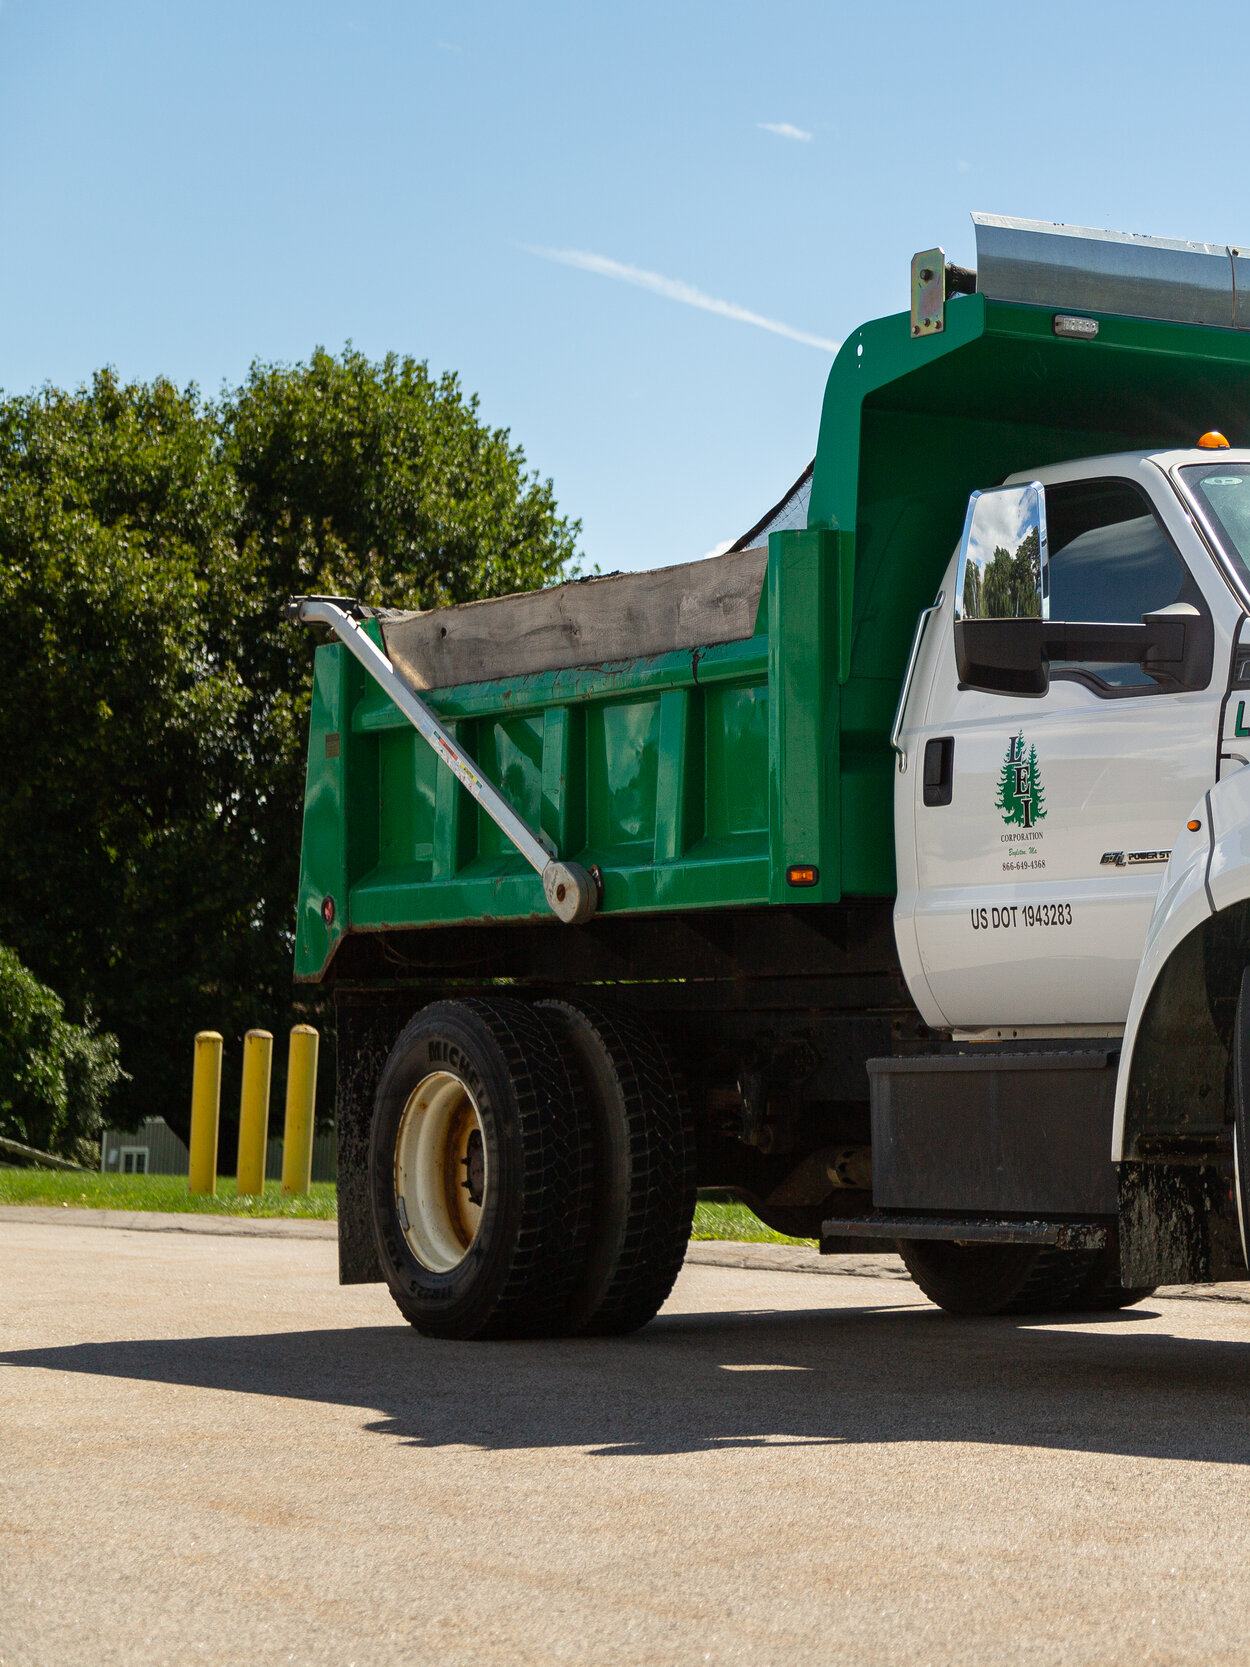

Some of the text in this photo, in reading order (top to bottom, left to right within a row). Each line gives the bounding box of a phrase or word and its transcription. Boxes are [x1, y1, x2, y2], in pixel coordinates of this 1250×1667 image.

[1001, 832, 1044, 842] CORPORATION
[1128, 852, 1158, 861] POWER
[1002, 860, 1046, 871] 866-649-4368
[971, 903, 1072, 930] US DOT 1943283
